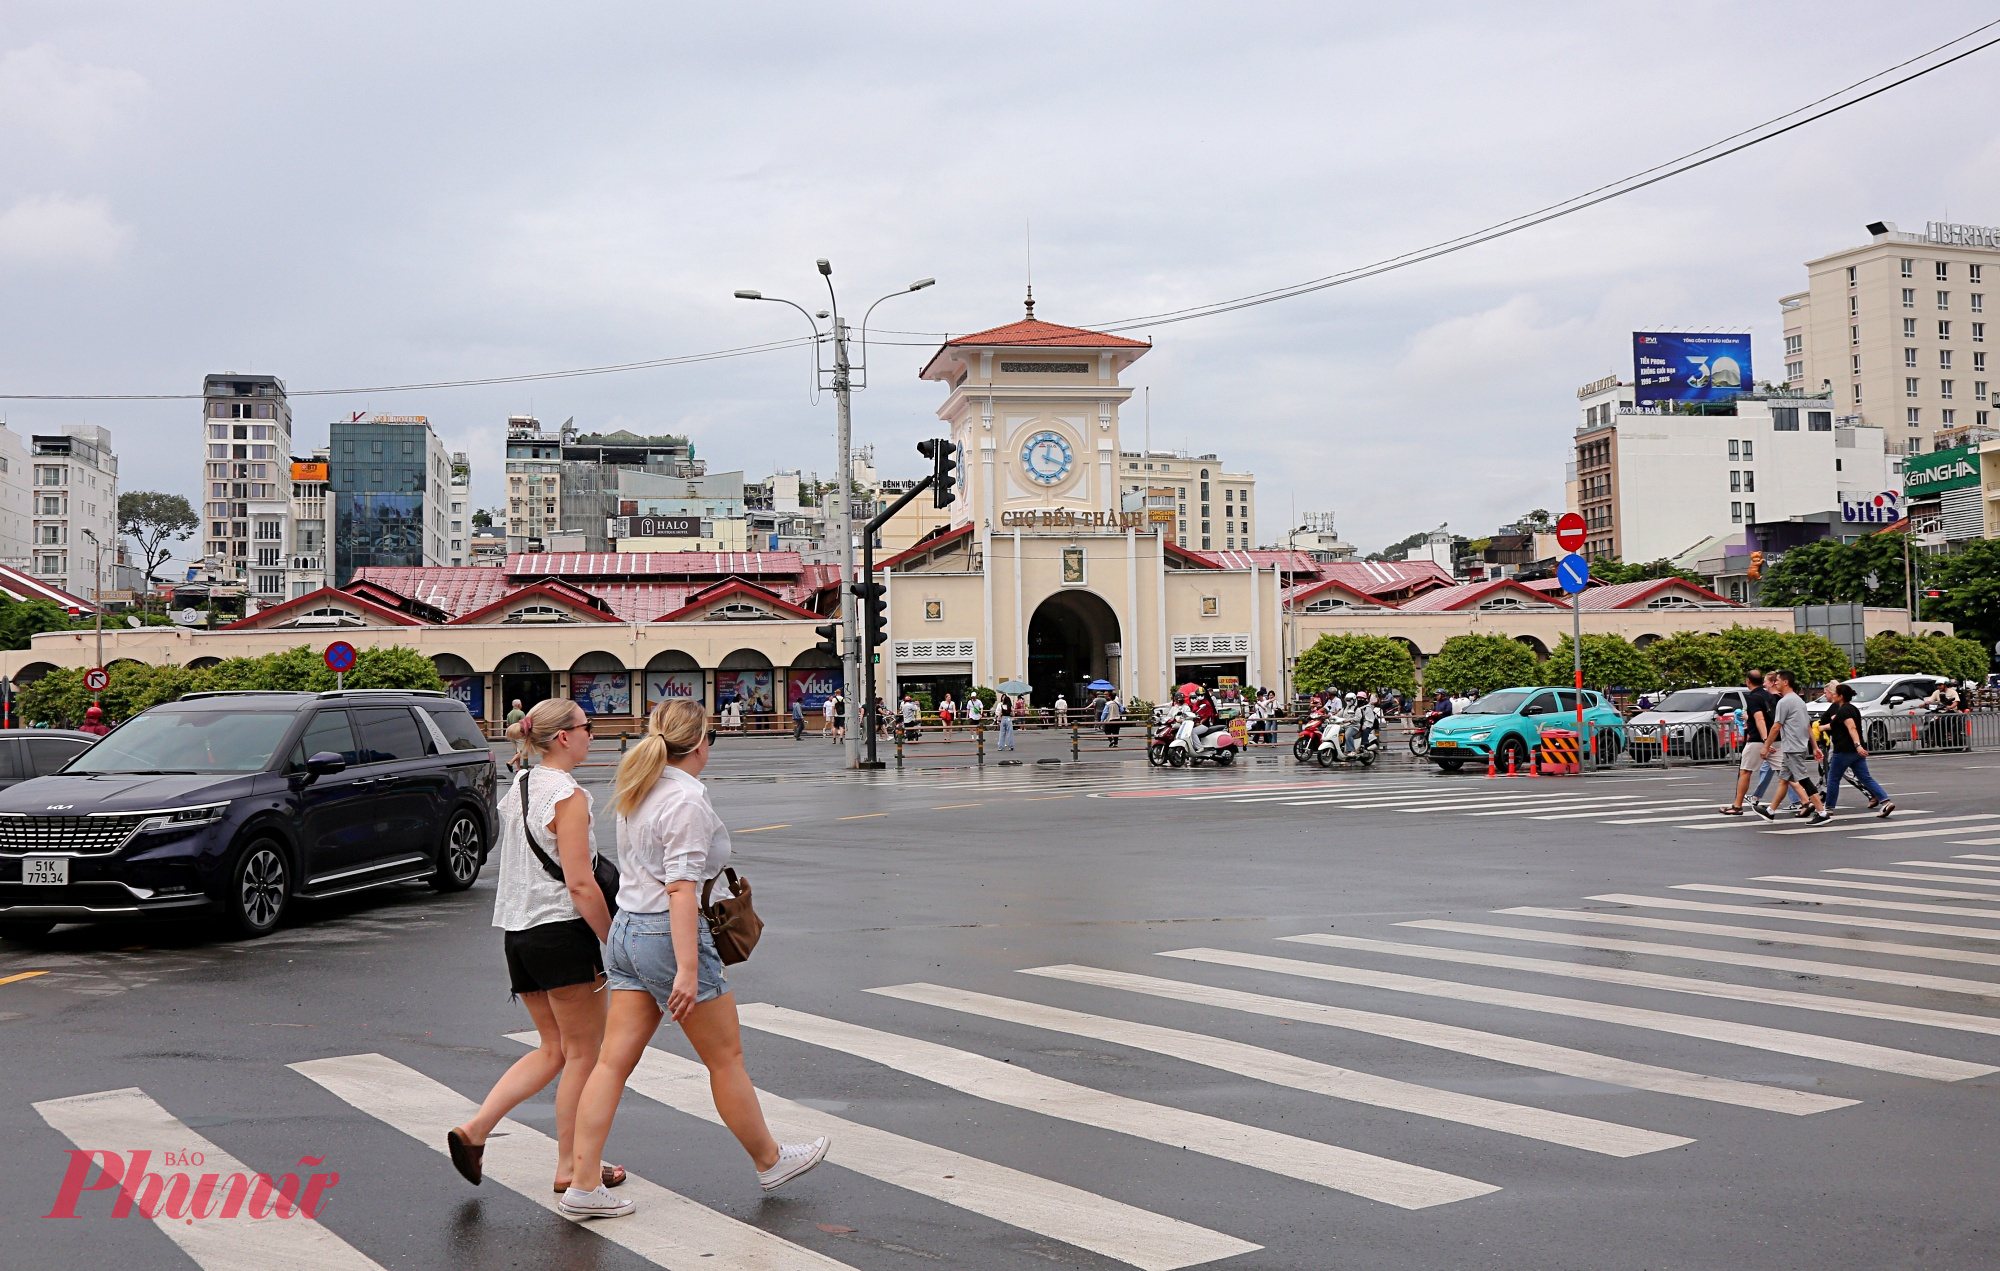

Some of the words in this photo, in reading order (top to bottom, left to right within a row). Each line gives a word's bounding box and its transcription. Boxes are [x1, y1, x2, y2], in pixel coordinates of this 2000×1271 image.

[1001, 509, 1037, 528] CHỢ
[1043, 506, 1075, 526] BẾN
[1082, 509, 1143, 526] THÀNH
[657, 521, 688, 530] HALO
[654, 675, 693, 697] Vikki
[795, 672, 833, 694] Vikki
[443, 685, 471, 701] ikki
[35, 861, 55, 872] 51K
[28, 873, 63, 883] 779.34
